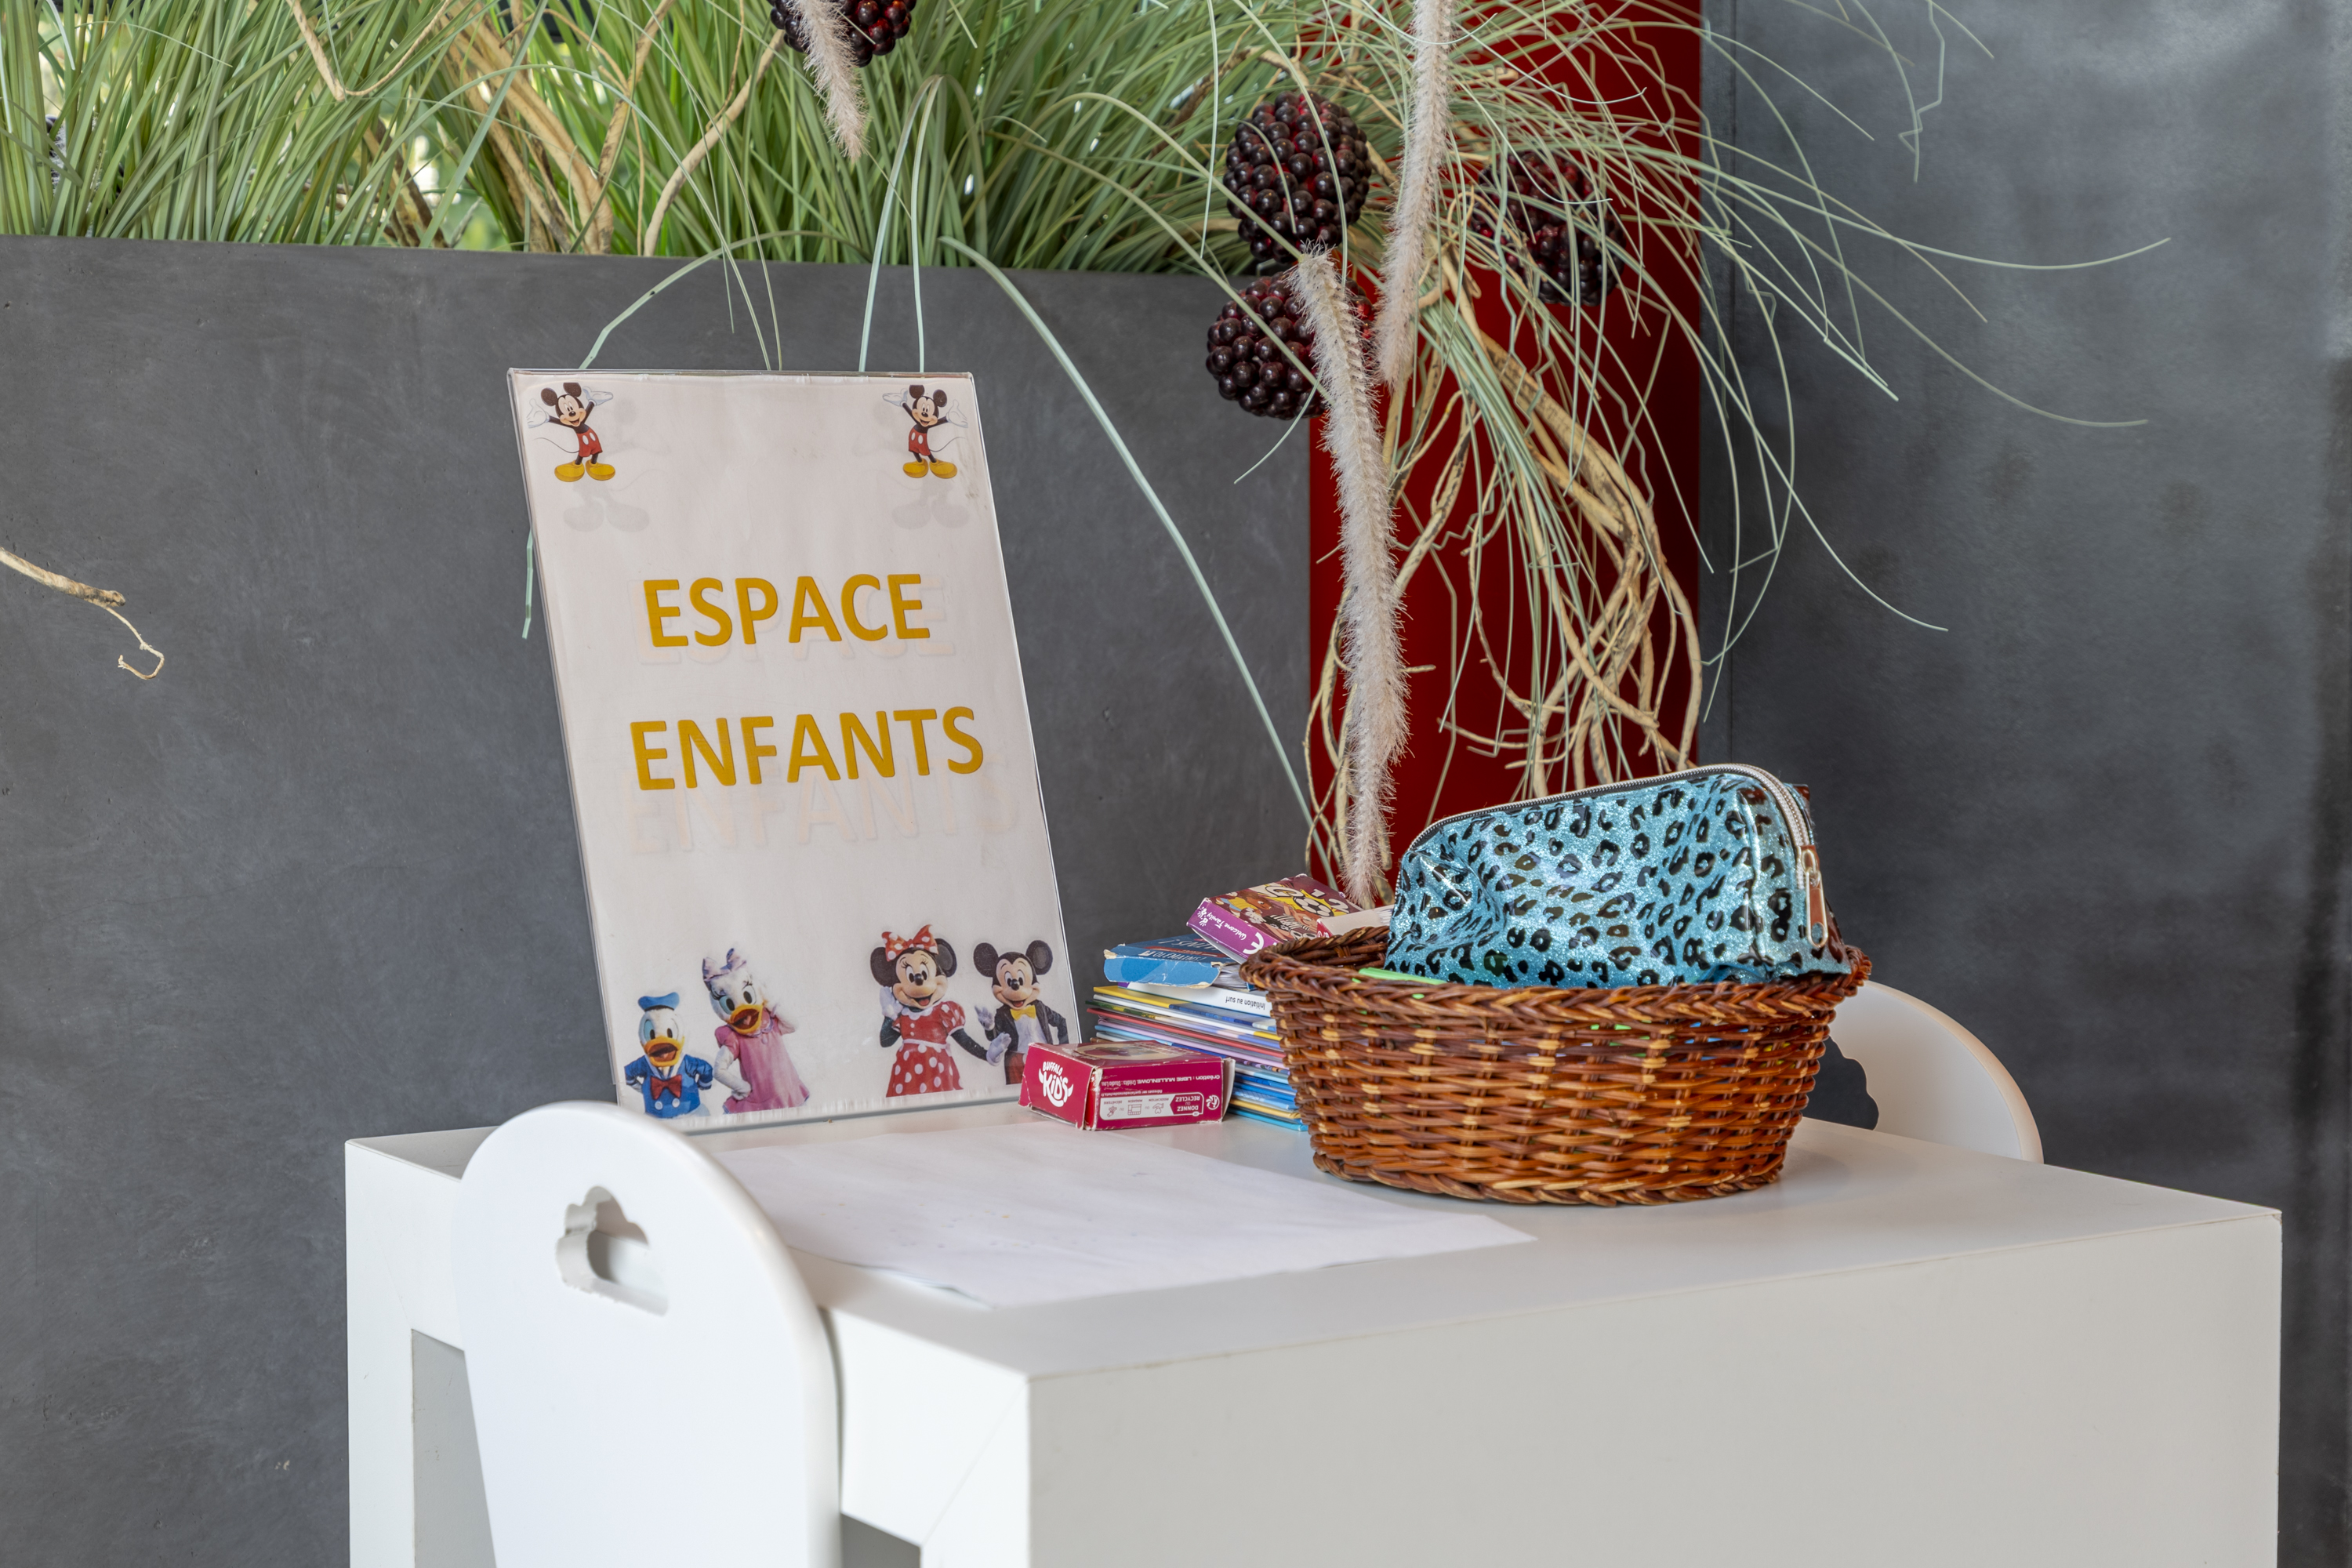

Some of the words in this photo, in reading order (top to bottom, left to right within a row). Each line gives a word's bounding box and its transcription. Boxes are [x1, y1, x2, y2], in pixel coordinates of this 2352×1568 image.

[644, 574, 930, 648] ESPACE
[630, 706, 983, 790] ENFANTS
[1207, 912, 1225, 929] Family
[1225, 922, 1247, 941] Welcome
[1244, 1000, 1265, 1010] Initiation
[1042, 1061, 1063, 1076] BUFFALO
